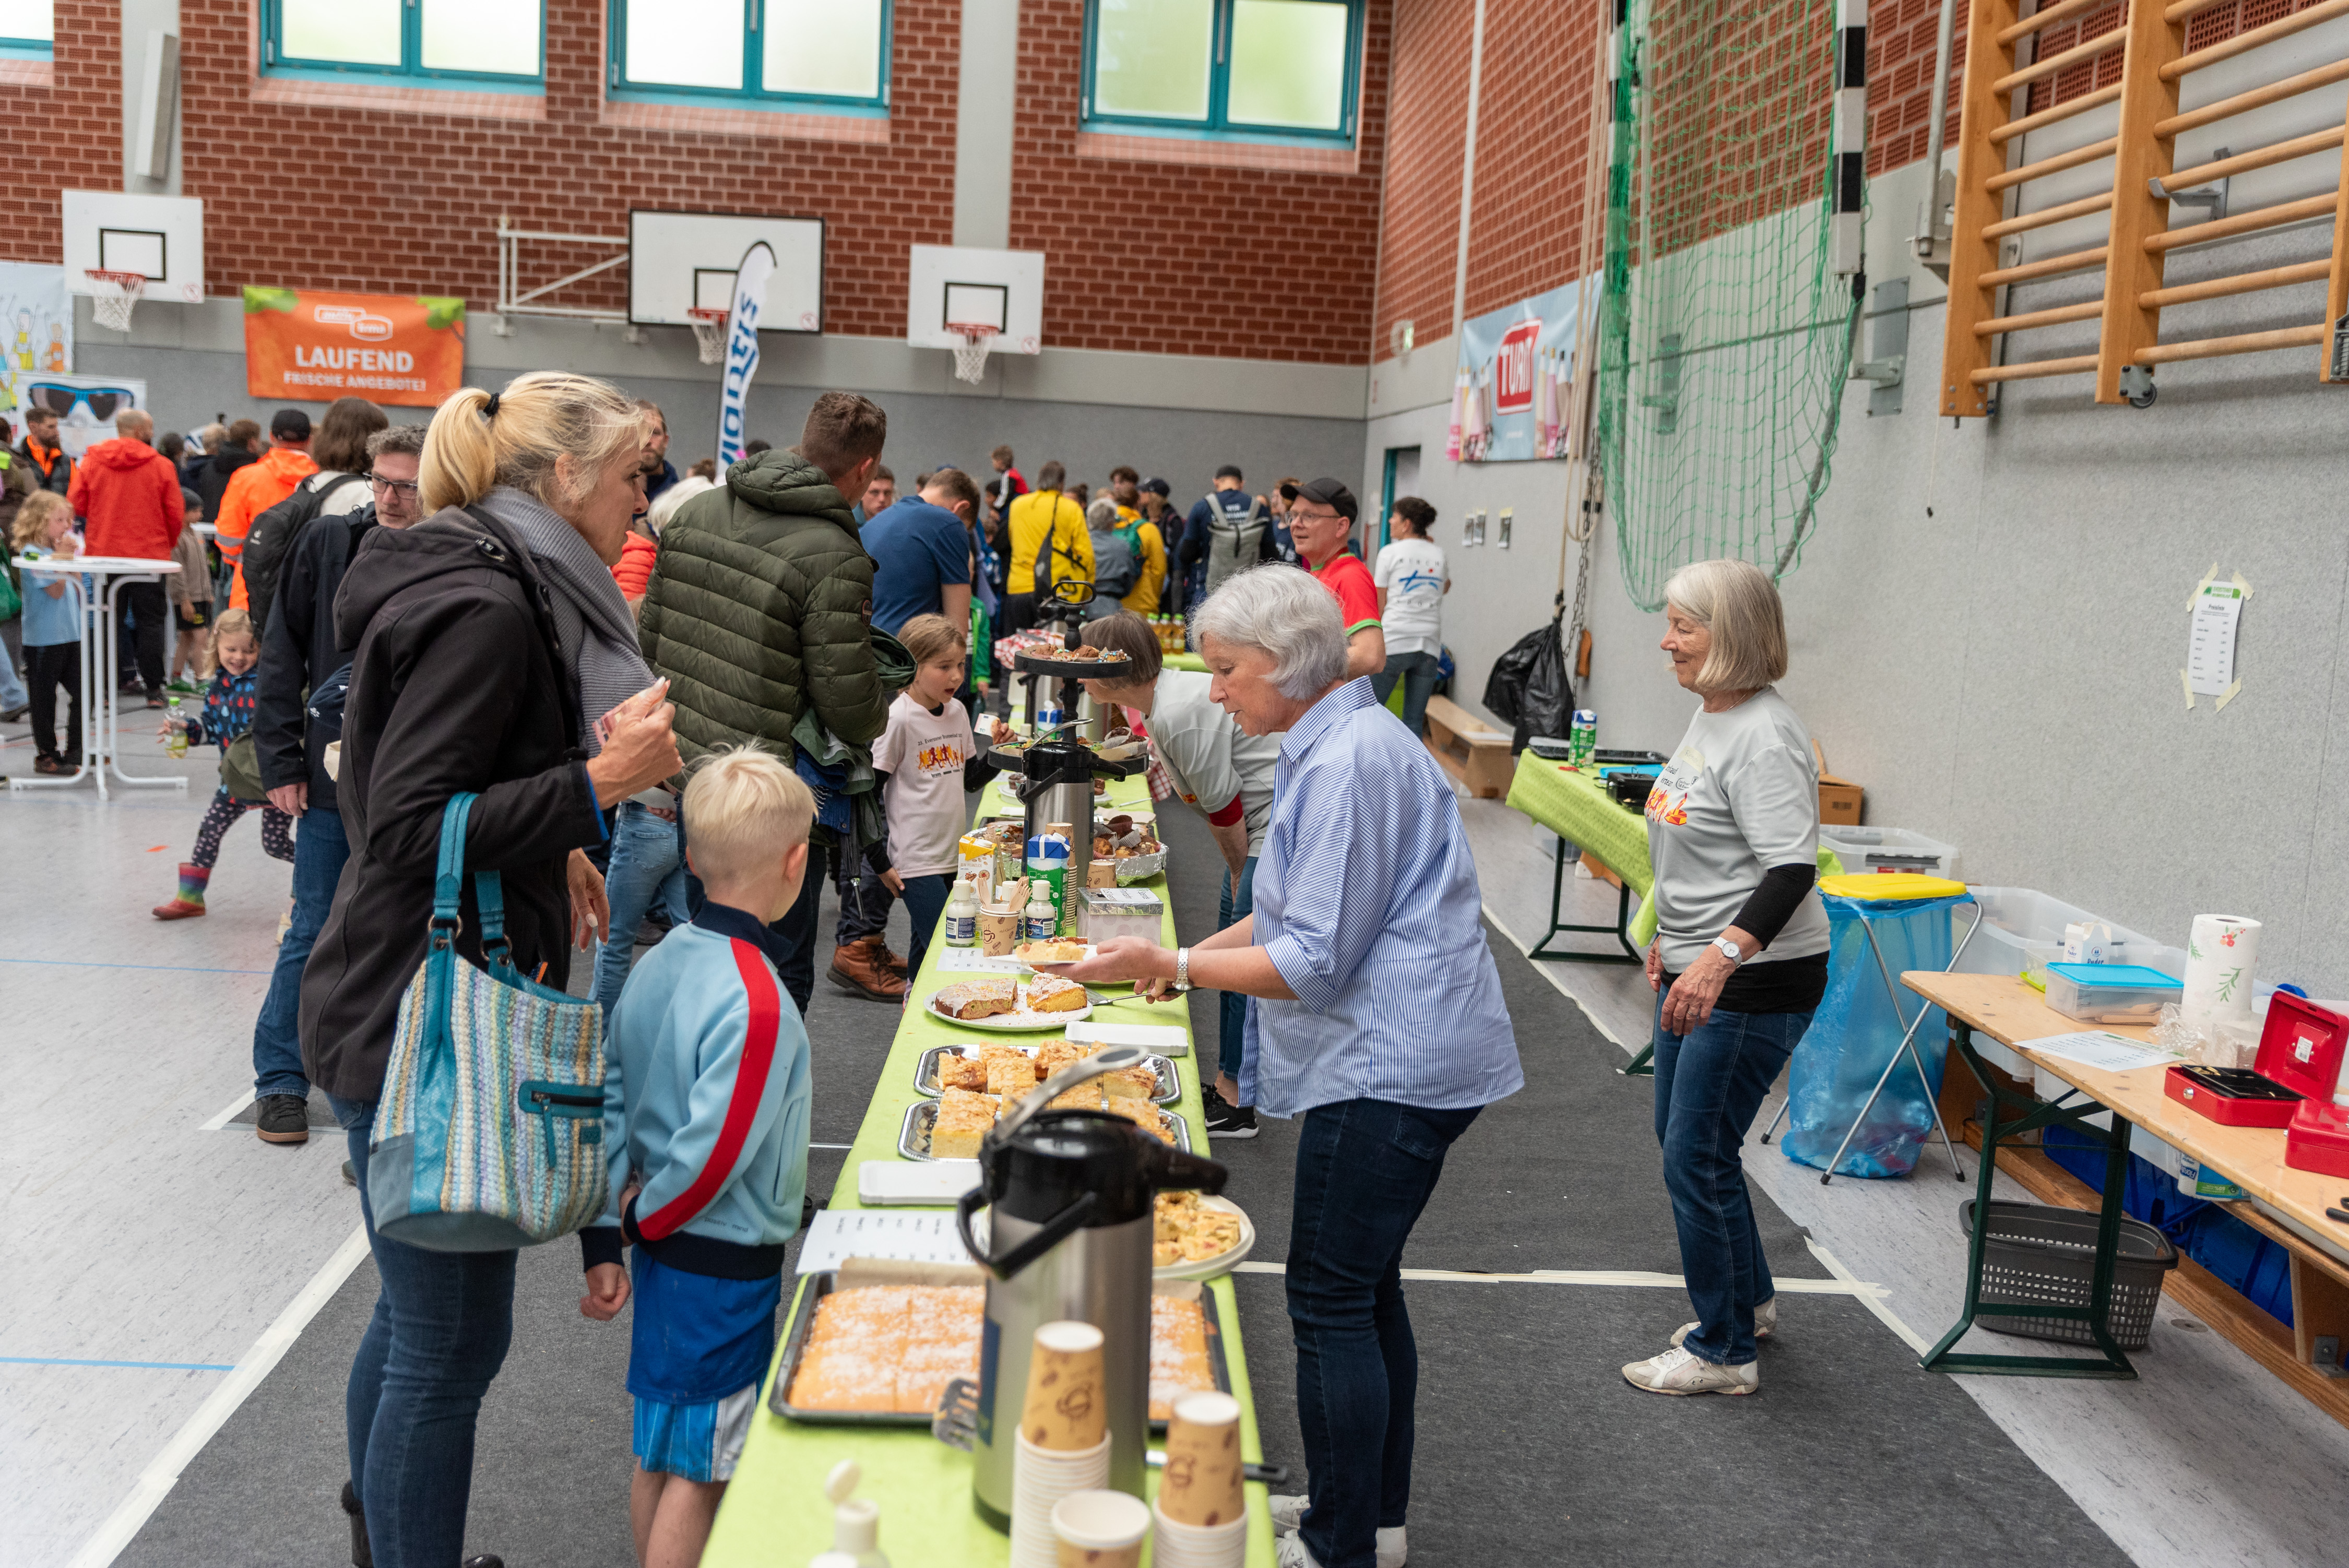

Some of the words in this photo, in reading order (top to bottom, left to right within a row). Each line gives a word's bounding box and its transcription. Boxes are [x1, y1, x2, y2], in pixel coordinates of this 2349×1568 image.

[294, 344, 414, 373] LAUFEND
[283, 370, 345, 387] FRISCHE
[346, 374, 426, 391] ANGEBOTE!
